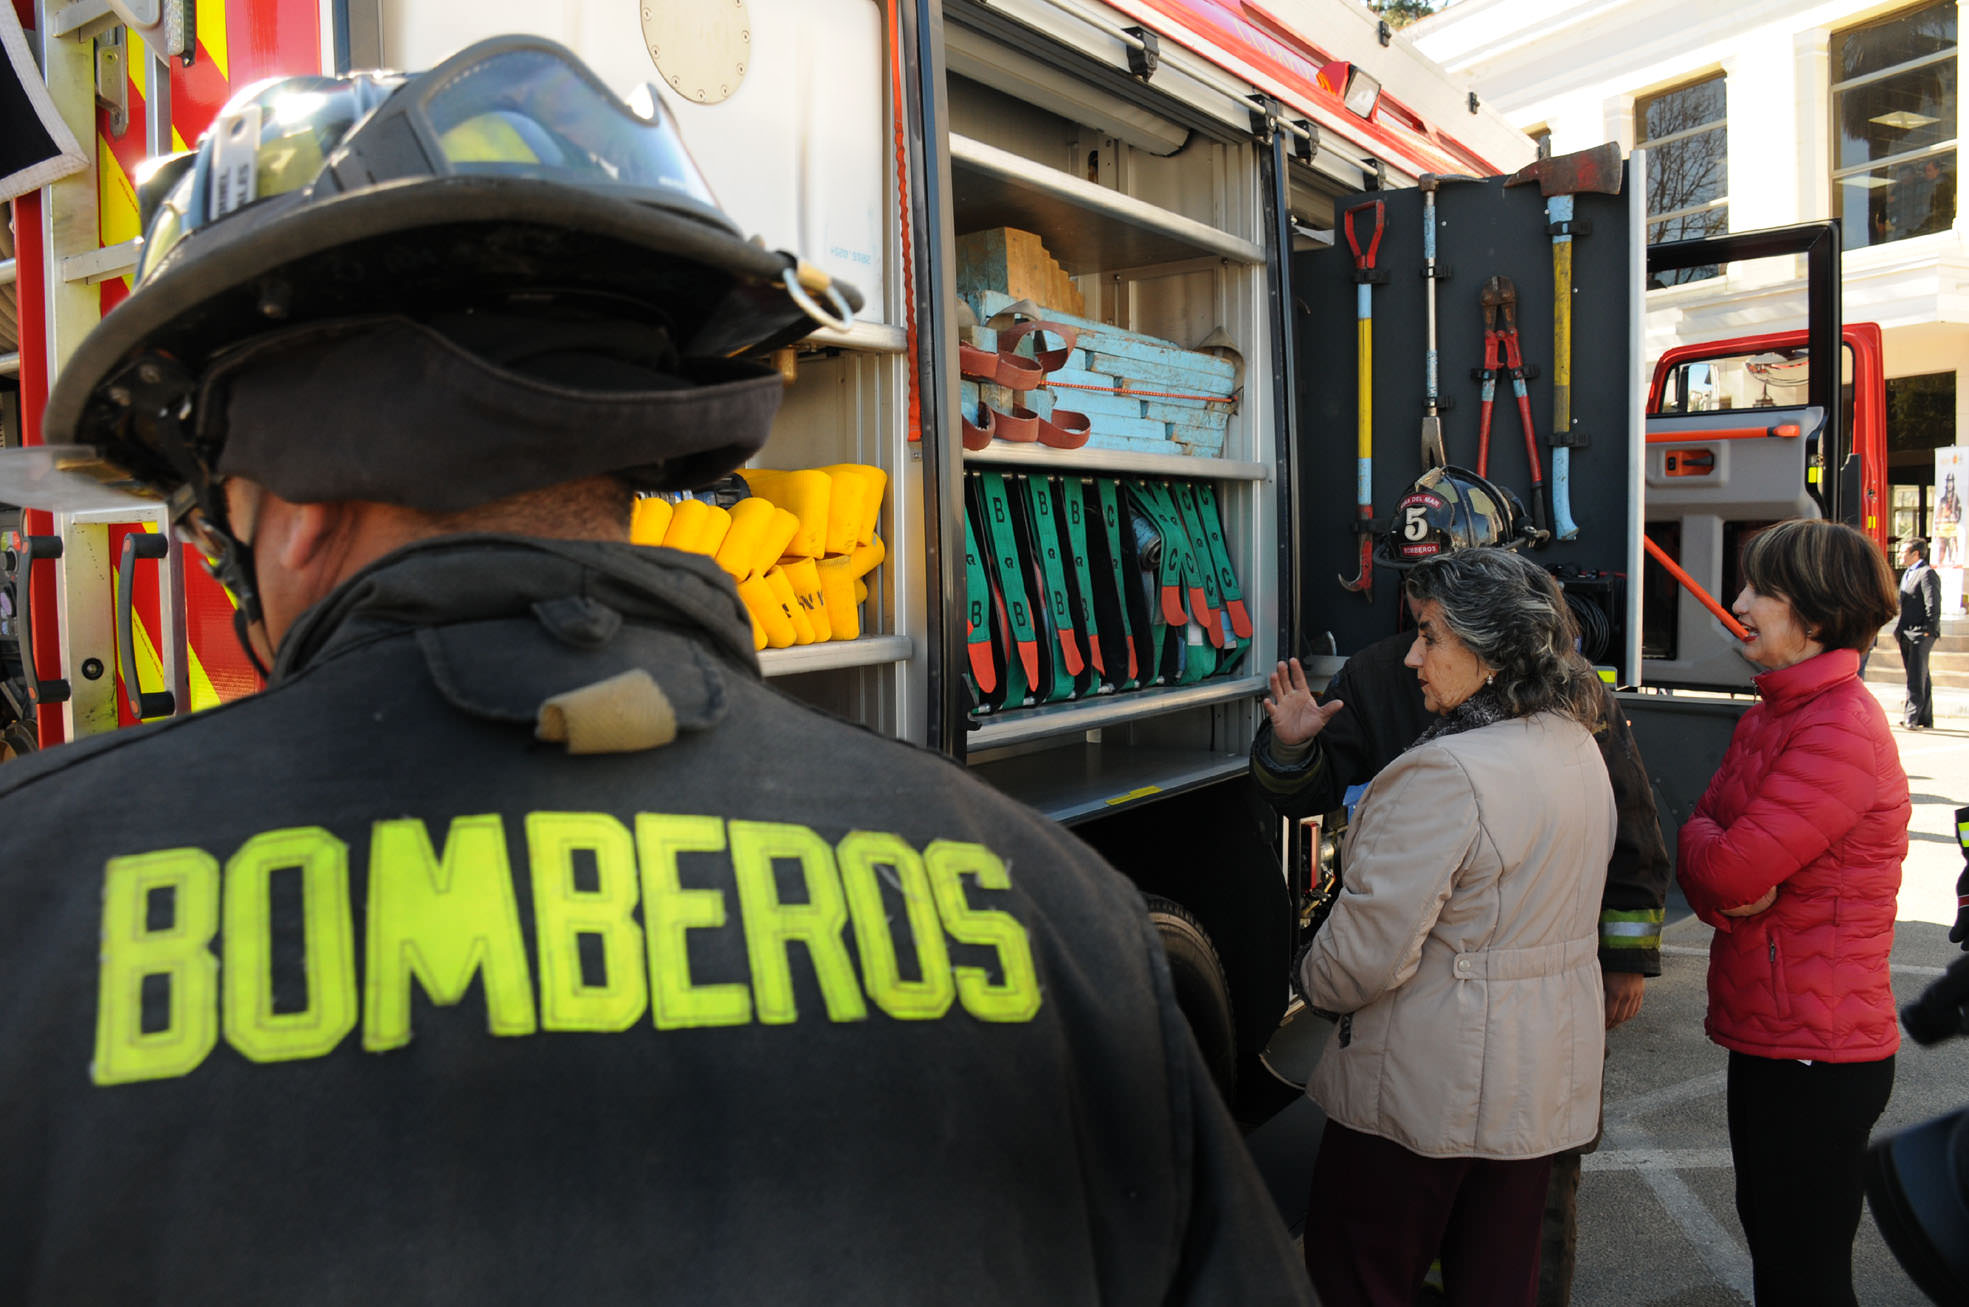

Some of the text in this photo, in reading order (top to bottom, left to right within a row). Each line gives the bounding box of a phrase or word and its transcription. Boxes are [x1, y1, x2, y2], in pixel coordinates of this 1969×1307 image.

[992, 497, 1005, 523] B
[1038, 491, 1048, 515] B
[1071, 500, 1081, 525] B
[1107, 504, 1115, 528] C
[1404, 506, 1428, 541] 5
[1169, 548, 1178, 571] C
[1403, 546, 1437, 554] BOMBEROS
[1185, 552, 1194, 574] C
[1206, 574, 1214, 597] C
[1222, 567, 1232, 588] C
[971, 600, 983, 628] B
[1012, 601, 1026, 627] B
[1054, 590, 1065, 615] B
[91, 812, 1042, 1086] BOMBEROS
